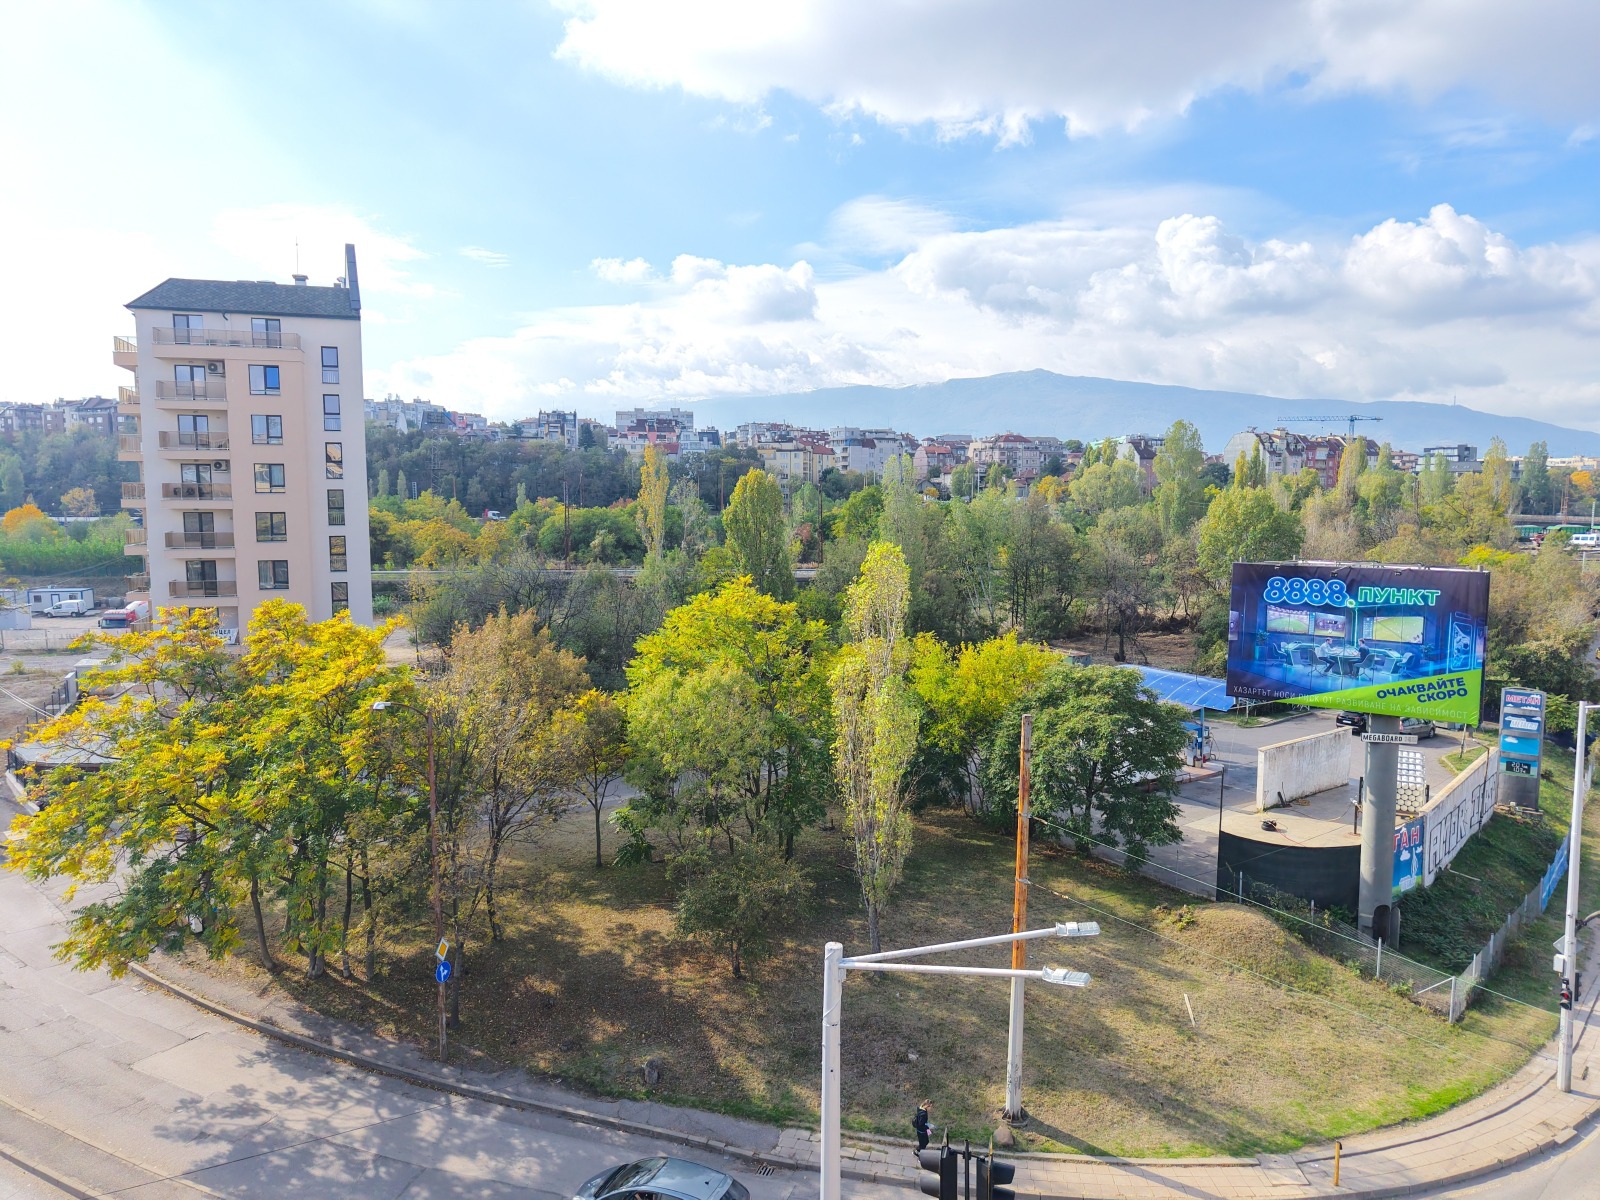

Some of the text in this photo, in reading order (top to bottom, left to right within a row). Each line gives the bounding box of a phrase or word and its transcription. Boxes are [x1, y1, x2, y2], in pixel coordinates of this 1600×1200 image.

[1376, 677, 1466, 699] ОЧАКВАЙТЕ
[1416, 687, 1468, 703] СКОРО
[1233, 685, 1271, 697] ХАЗАРТЪТ
[1273, 690, 1296, 699] НОСИ
[1322, 696, 1332, 704] ОТ
[1336, 697, 1386, 710] РАЗВИВАНЕ
[1390, 704, 1402, 712] НА
[1404, 704, 1468, 719] ЗАВИСИМОСТ
[1505, 694, 1541, 706] МЕТАН
[1362, 734, 1403, 742] MEGABOARD
